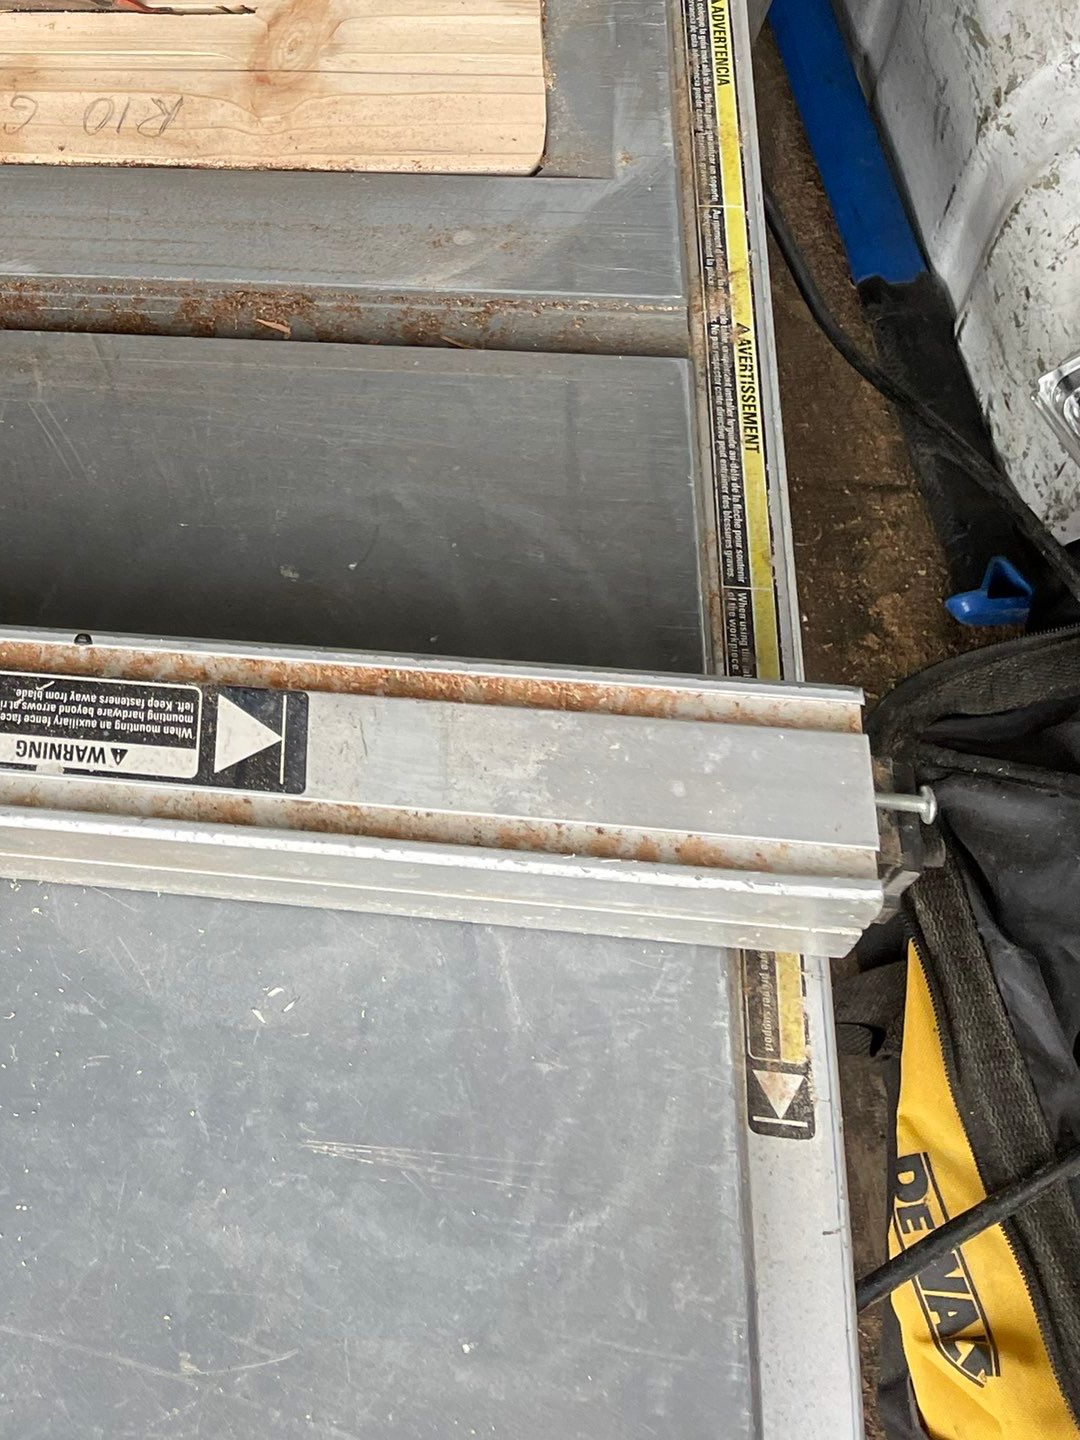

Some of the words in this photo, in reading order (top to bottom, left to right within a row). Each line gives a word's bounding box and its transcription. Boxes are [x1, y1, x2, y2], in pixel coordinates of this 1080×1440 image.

[711, 4, 730, 86] ADVERTENCIA
[81, 92, 184, 139] RIO
[736, 339, 759, 454] AVERTISSEMENT
[732, 529, 742, 548] pour
[737, 592, 748, 618] When
[738, 621, 750, 646] using
[12, 688, 42, 700] blade.
[44, 691, 67, 702] from
[69, 691, 96, 702] away
[9, 700, 18, 710] at
[21, 701, 56, 712] arrows
[98, 695, 145, 708] fasteners
[147, 696, 172, 710] Keep
[58, 703, 94, 717] beyond
[96, 706, 144, 720] hardware
[146, 709, 193, 724] mounting
[23, 713, 50, 726] fence
[52, 714, 97, 730] auxiliary
[99, 720, 111, 729] an
[114, 719, 160, 734] mounting
[162, 725, 192, 738] When
[15, 740, 106, 764] WARNING
[760, 1010, 773, 1052] support
